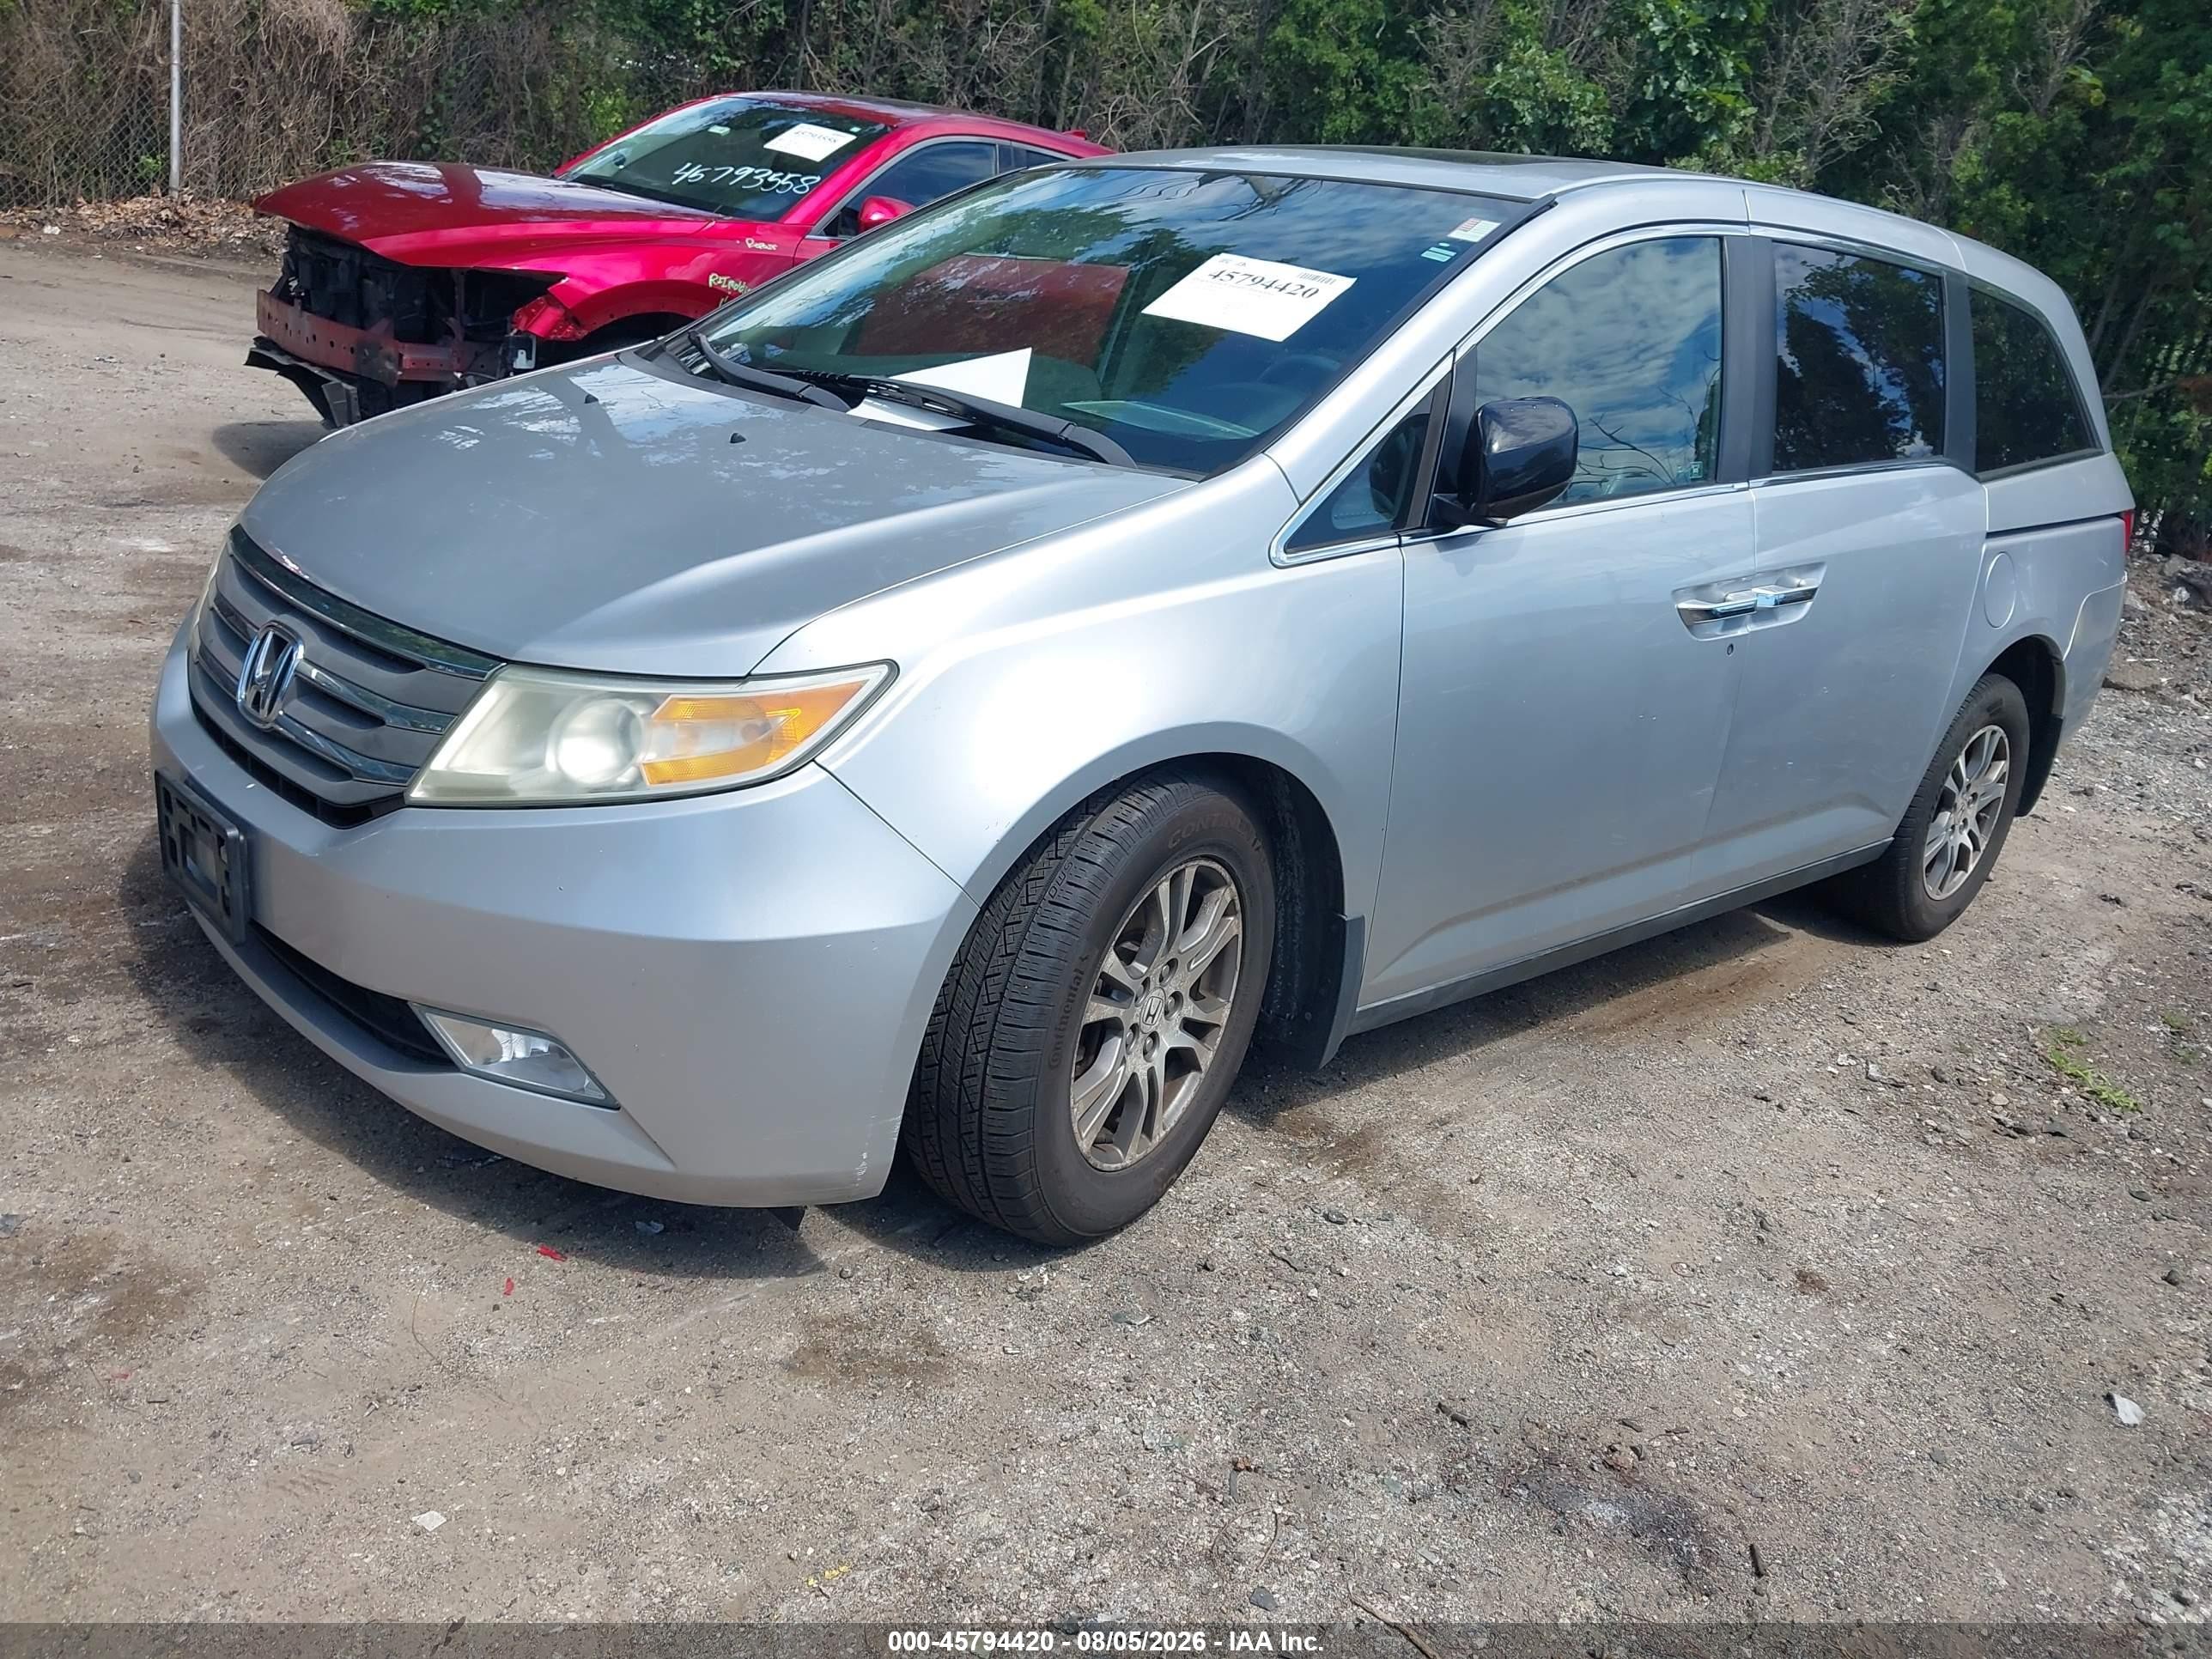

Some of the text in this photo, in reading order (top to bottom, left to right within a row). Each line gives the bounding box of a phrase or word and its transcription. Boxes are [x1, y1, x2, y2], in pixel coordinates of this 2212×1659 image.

[672, 161, 822, 194] 45793558
[1207, 268, 1320, 300] 45794420
[1048, 860, 1074, 899] DWS
